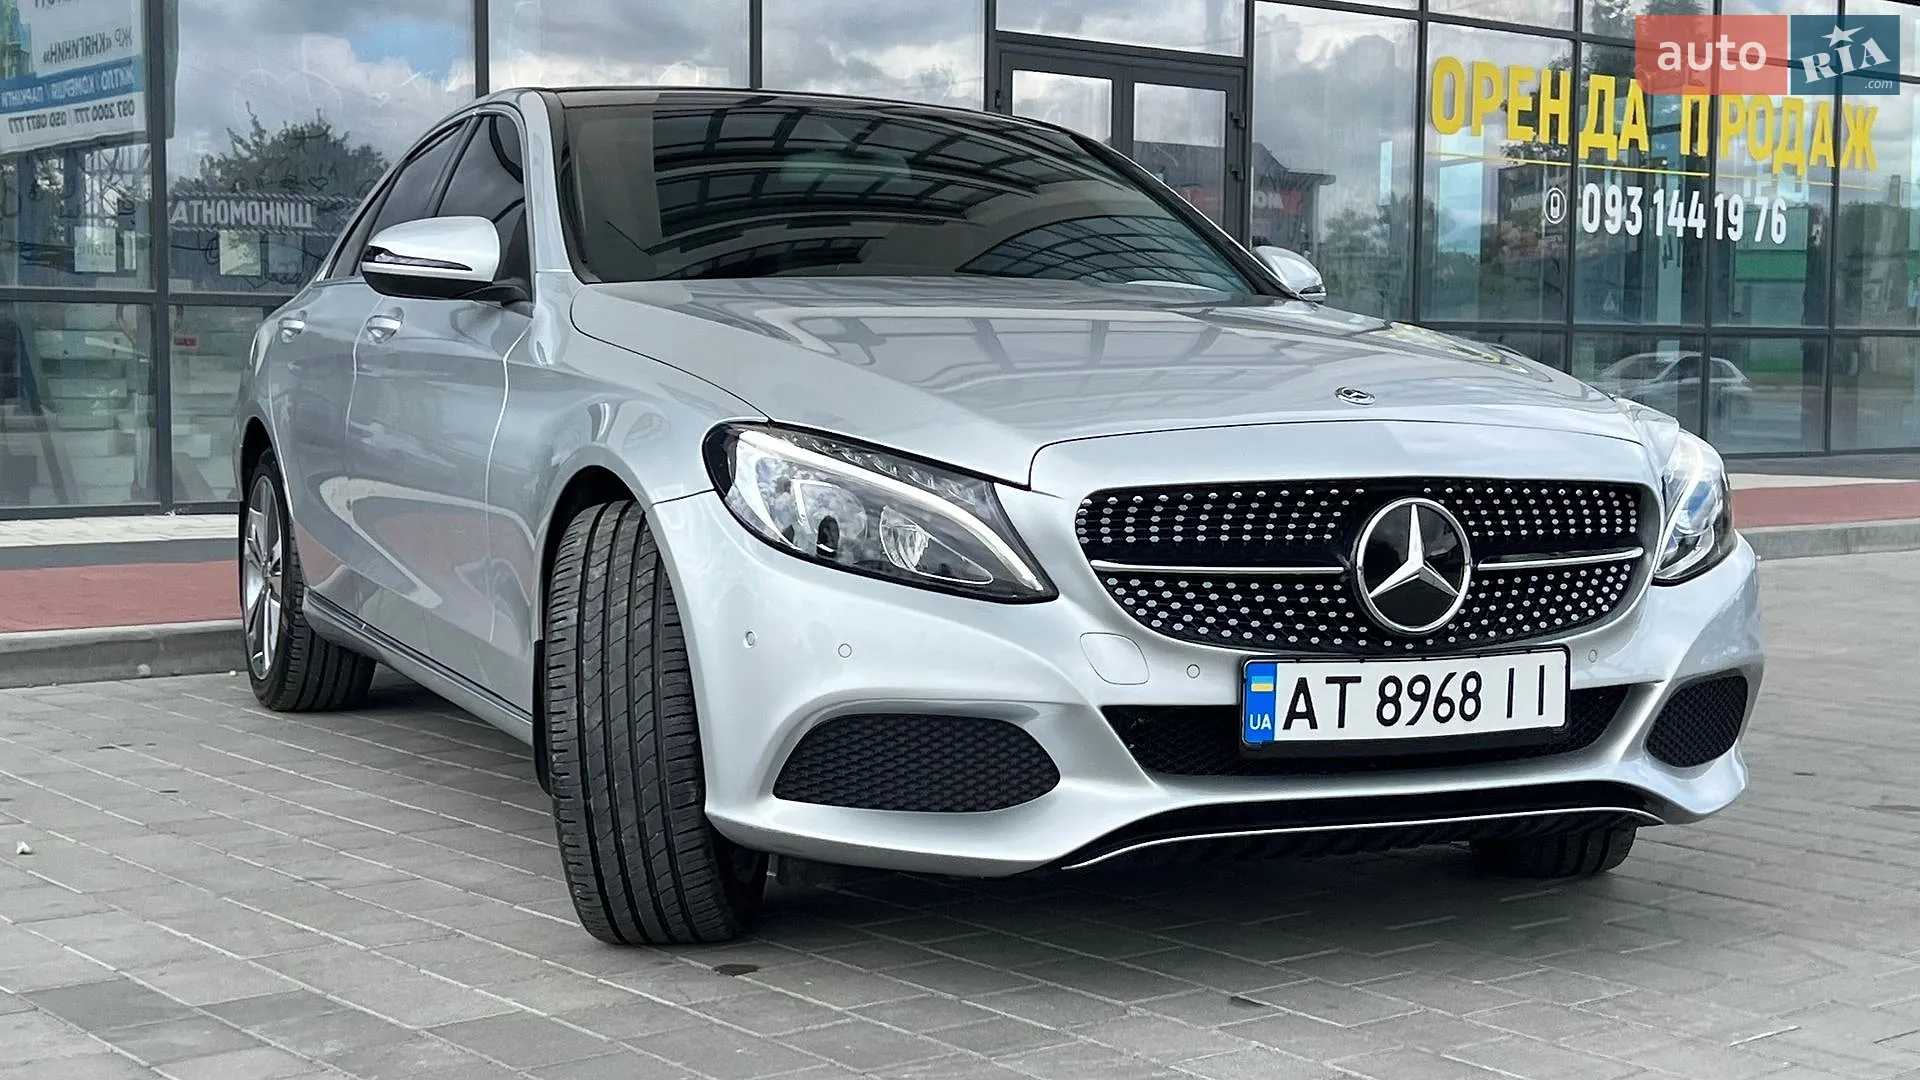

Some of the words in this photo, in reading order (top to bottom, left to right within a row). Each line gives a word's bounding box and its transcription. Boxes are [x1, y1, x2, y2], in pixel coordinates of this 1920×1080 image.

[1430, 56, 1650, 161] ОРЕНДА
[1680, 84, 1878, 175] ПРОДАЖ
[1582, 182, 1643, 236] 093
[1653, 188, 1706, 239] 144
[1714, 192, 1744, 242] 19
[1753, 197, 1787, 245] 76
[1249, 713, 1272, 730] UA
[1282, 676, 1362, 730] AT
[1376, 670, 1483, 727] 8968
